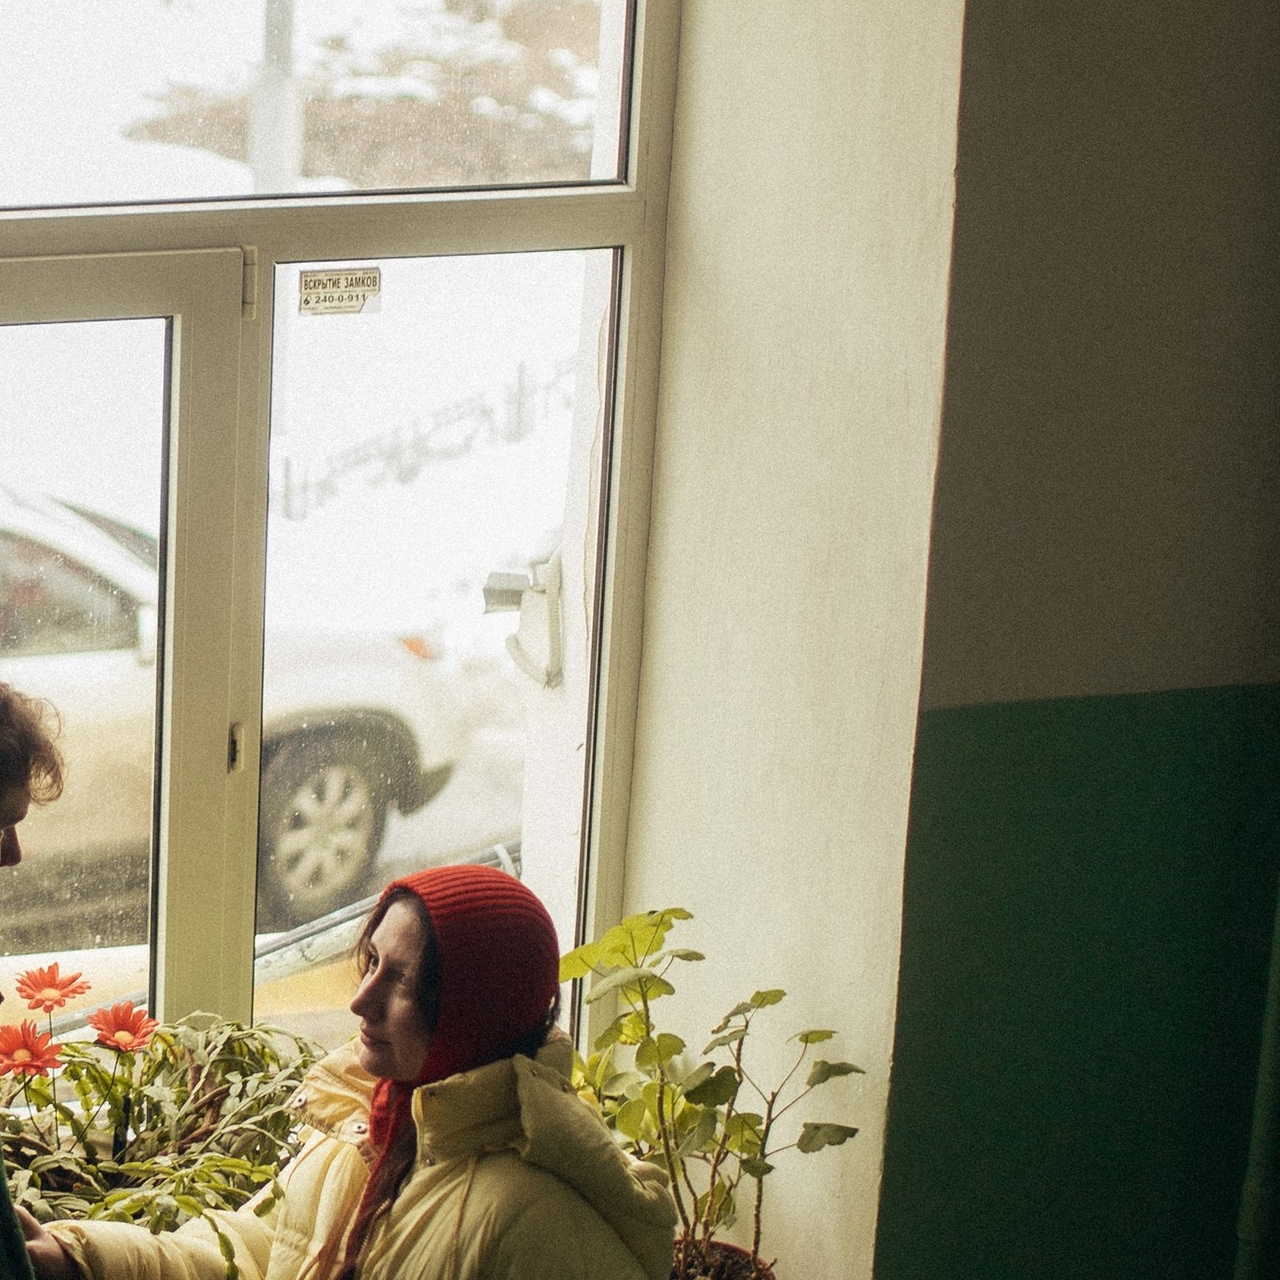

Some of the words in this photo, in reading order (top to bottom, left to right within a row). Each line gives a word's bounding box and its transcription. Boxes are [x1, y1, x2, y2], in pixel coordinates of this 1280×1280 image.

[304, 278, 341, 290] ВСКРЫТИЕ
[344, 276, 377, 288] ЗАМКОВ
[315, 294, 366, 303] 240-0-911
